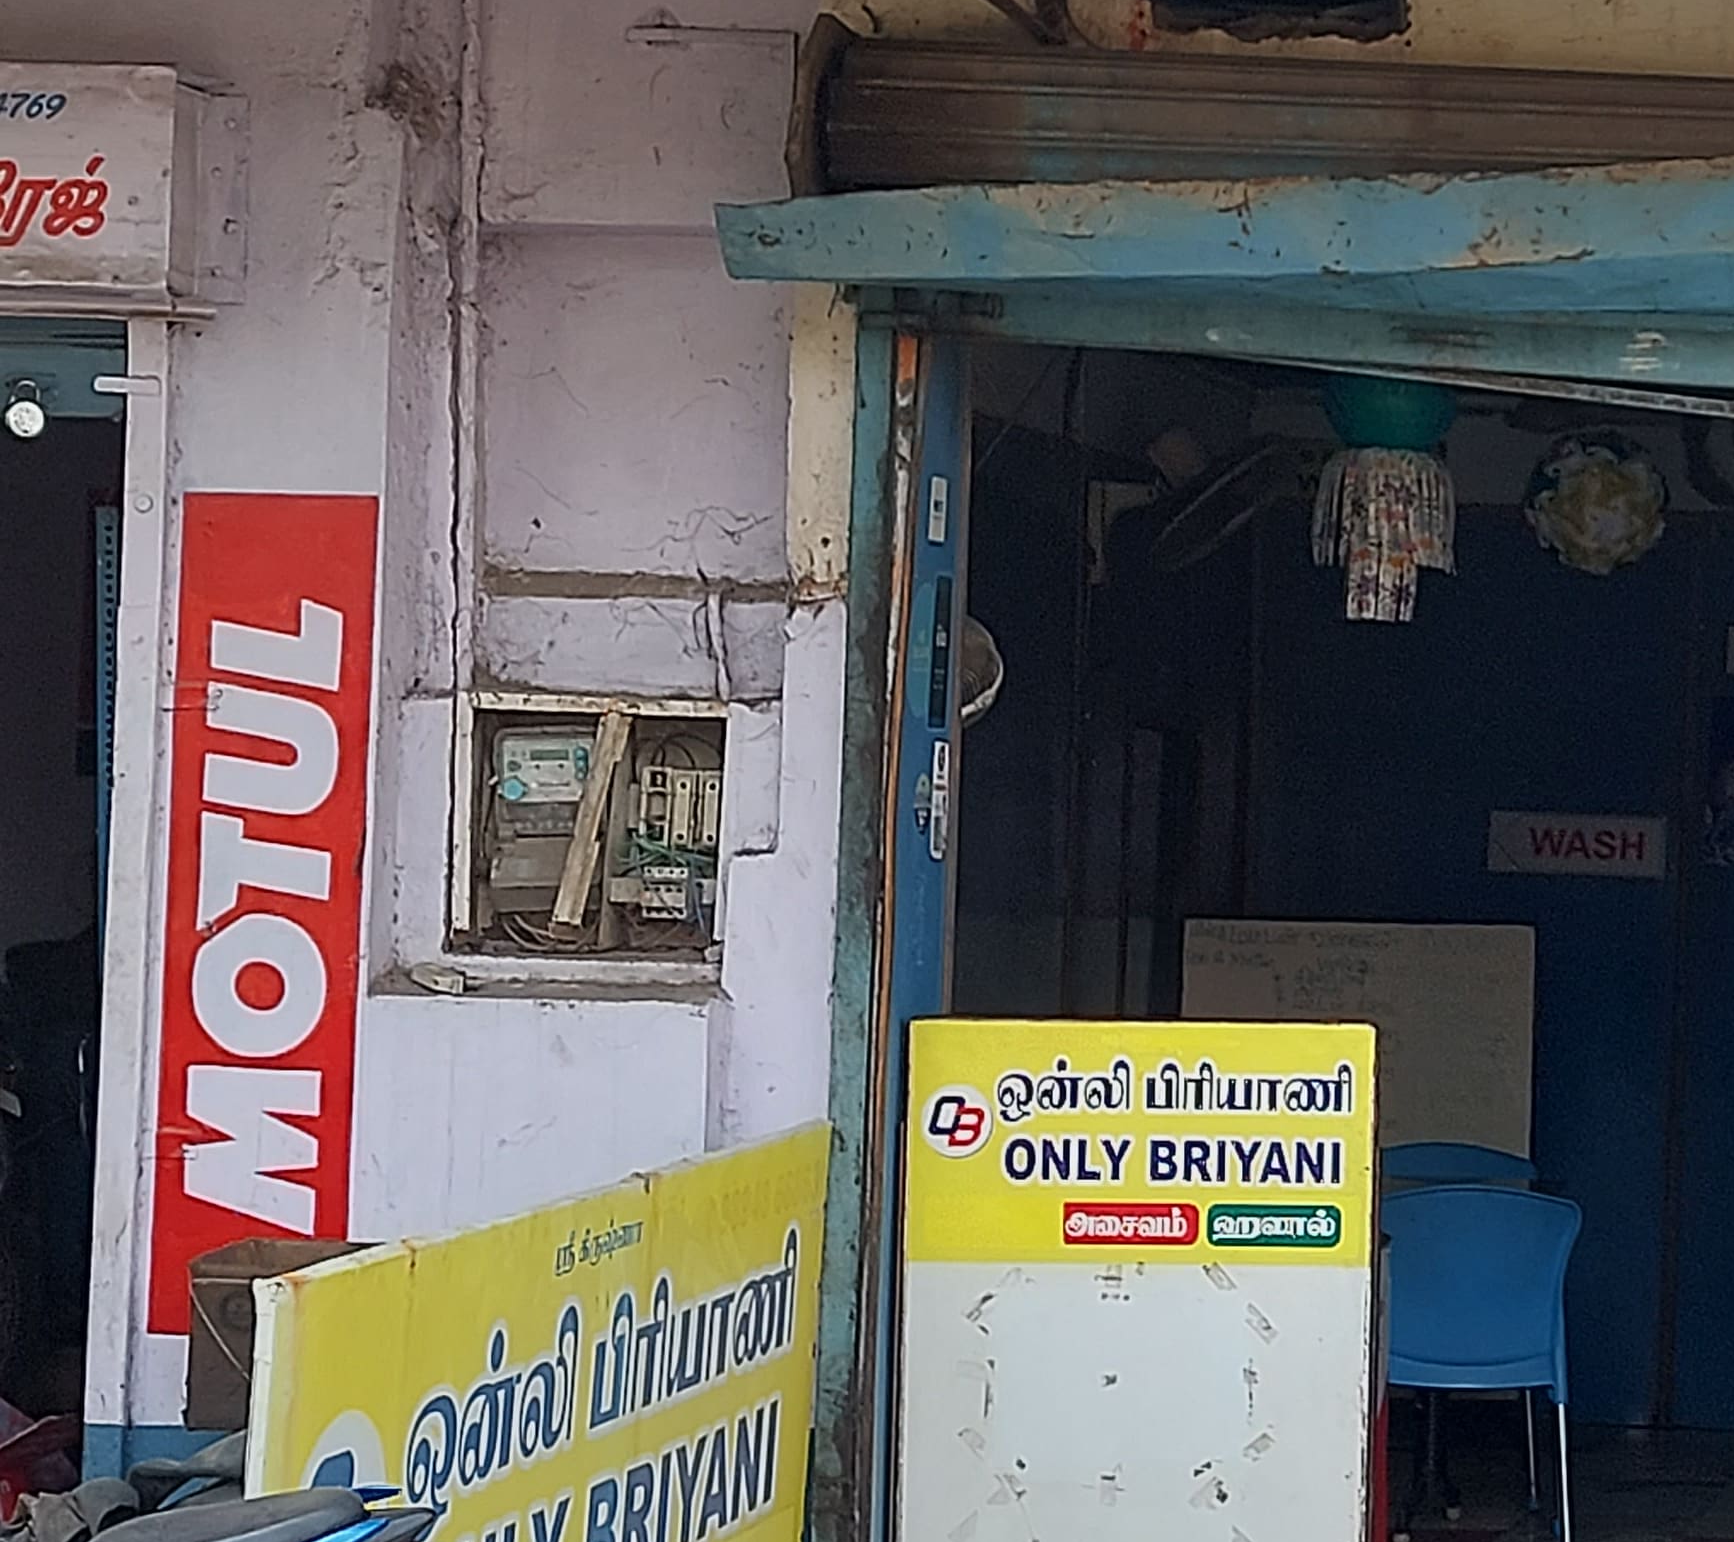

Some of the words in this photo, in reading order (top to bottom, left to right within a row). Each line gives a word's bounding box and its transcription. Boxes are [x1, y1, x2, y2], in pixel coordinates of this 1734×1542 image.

[1530, 827, 1646, 861] WASH
[183, 598, 344, 1236] MOTUL
[997, 1060, 1130, 1122] ஒன்லி
[1145, 1062, 1353, 1114] பிரியாணி
[1003, 1138, 1131, 1182] ONLY
[1149, 1139, 1342, 1185] BRIYANI
[1065, 1207, 1187, 1237] அசைவம்
[404, 1305, 580, 1539] ஒன்லி
[589, 1227, 798, 1433] பிரியாணி
